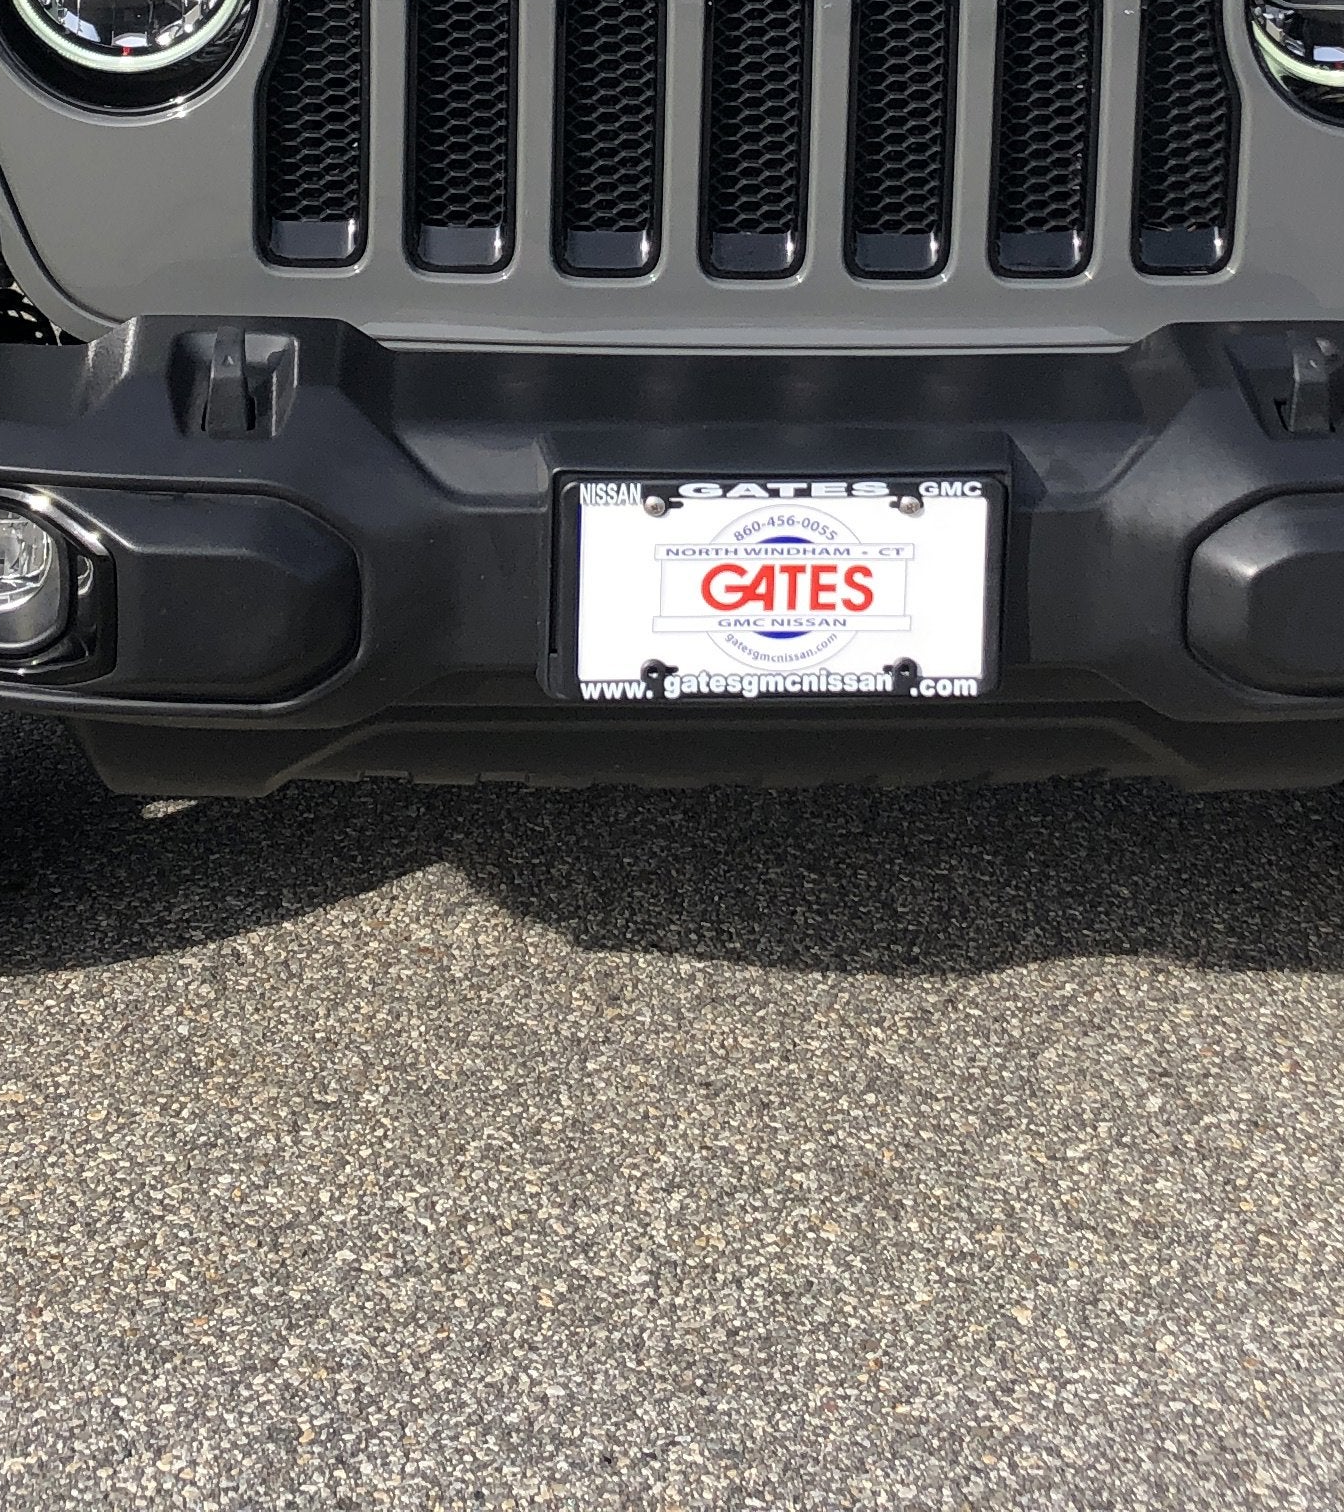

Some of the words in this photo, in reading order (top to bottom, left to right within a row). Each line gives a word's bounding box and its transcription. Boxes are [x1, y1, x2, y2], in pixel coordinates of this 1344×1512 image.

[579, 482, 643, 506] NISSAN
[678, 482, 890, 498] GATES
[918, 481, 982, 497] GMC
[733, 514, 838, 543] 860-456-0055
[665, 547, 739, 557] NORTH
[743, 546, 851, 557] WINDHAM
[878, 547, 905, 557] CT
[701, 563, 875, 612] GATES
[717, 618, 765, 628] GMC
[770, 617, 848, 628] NISSAN
[724, 632, 838, 664] gatesgmcnissan.com
[579, 681, 654, 701] www.
[663, 670, 894, 699] gatesgmcnissan
[909, 677, 978, 698] .com
